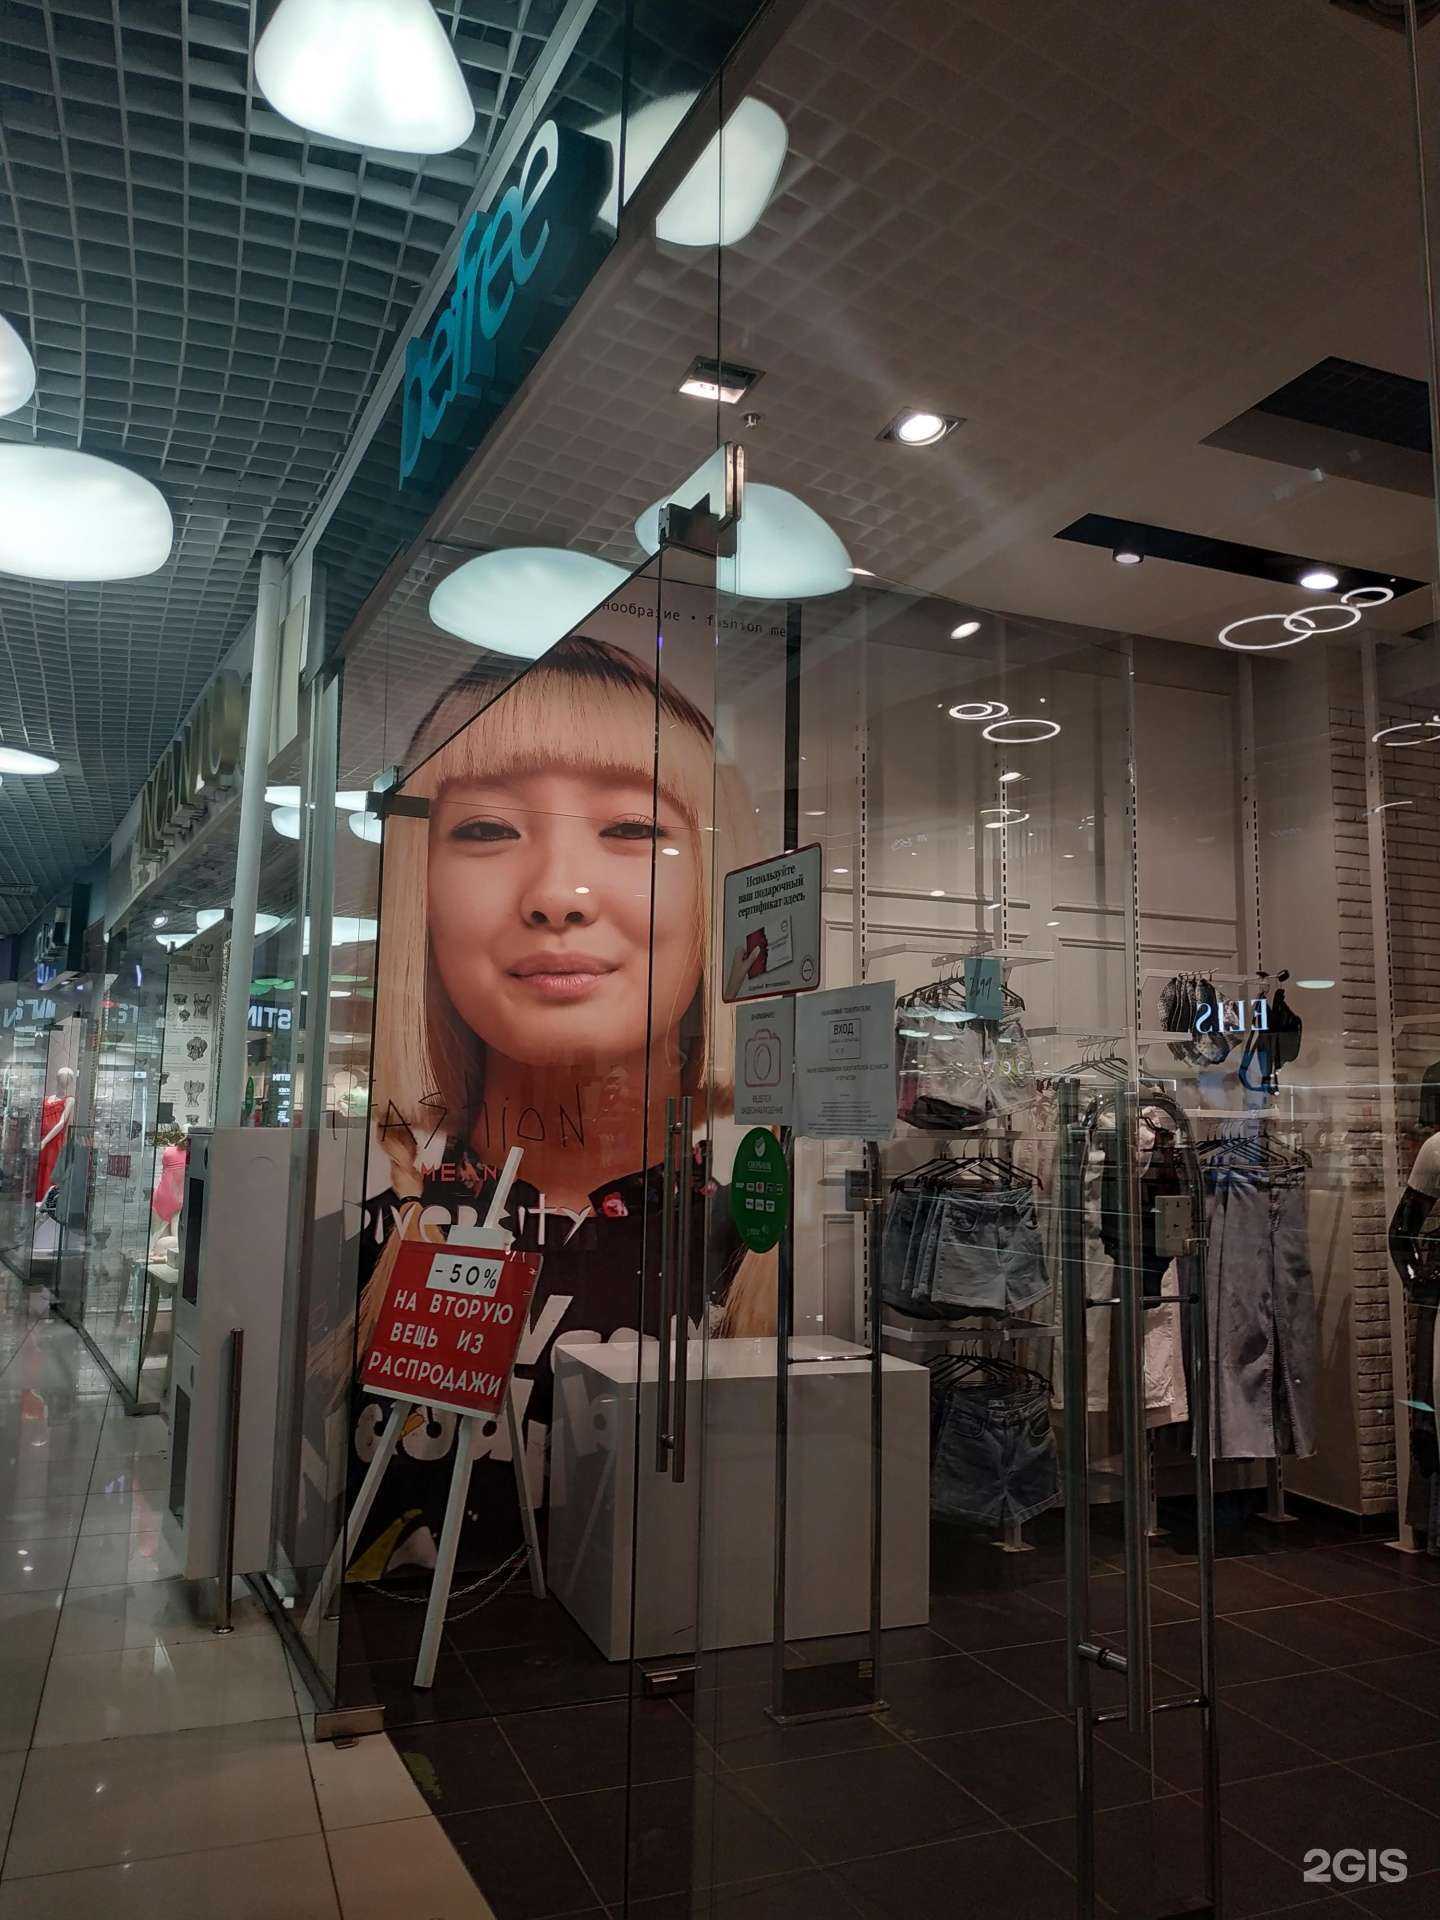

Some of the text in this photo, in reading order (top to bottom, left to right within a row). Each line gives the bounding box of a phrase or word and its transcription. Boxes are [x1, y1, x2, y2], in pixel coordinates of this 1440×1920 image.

[602, 601, 681, 621] нообраие
[705, 614, 761, 633] fshion
[746, 864, 796, 888] Используйте
[754, 873, 804, 899] подарочный
[737, 892, 806, 919] сертификат здесь
[833, 1022, 855, 1036] ВХОД
[421, 1162, 498, 1182] MEAN
[435, 1263, 497, 1290] -50%
[393, 1288, 514, 1325] НА ВТОРУЮ
[389, 1322, 485, 1355] ВЕЩЬ ИЗ
[367, 1353, 503, 1400] РАСПРОДАЖИ
